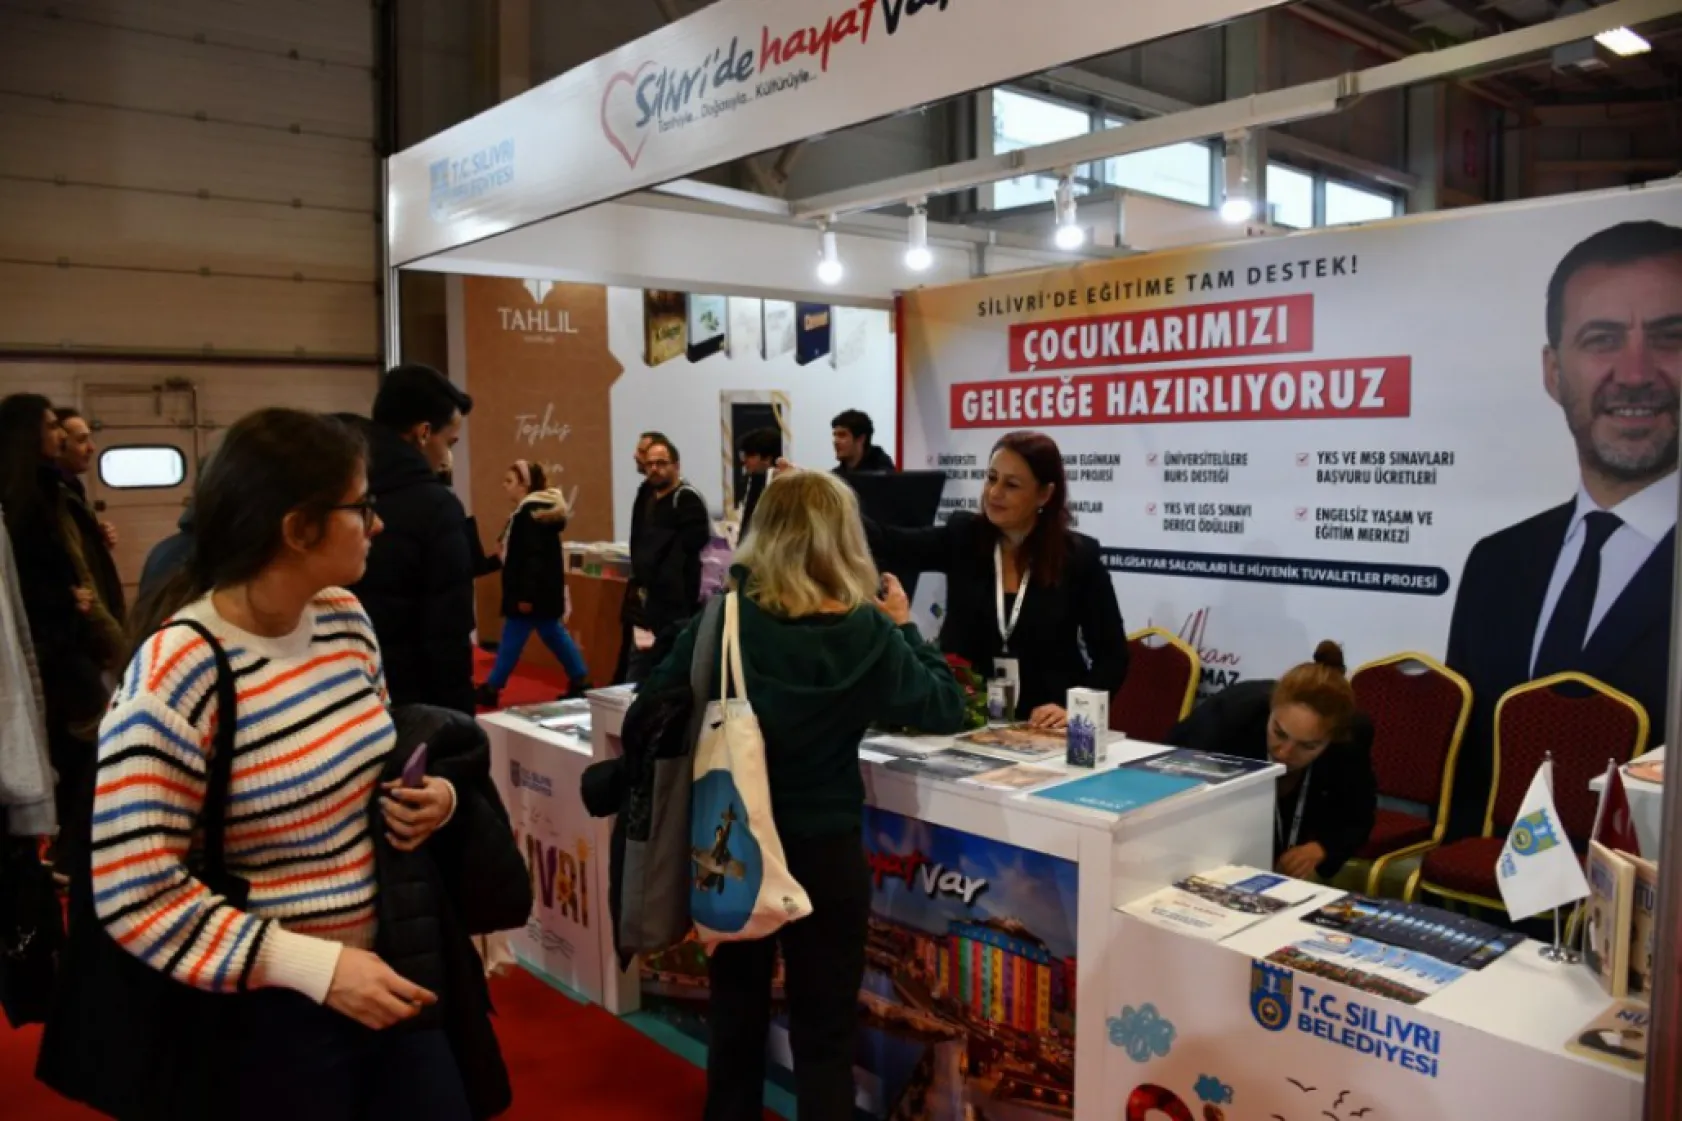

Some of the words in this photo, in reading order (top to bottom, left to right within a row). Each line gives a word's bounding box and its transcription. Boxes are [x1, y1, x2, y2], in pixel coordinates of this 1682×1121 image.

[759, 0, 877, 72] hayat
[977, 289, 1077, 318] SİLİVRİ'DE
[1087, 276, 1175, 305] EĞİTİME
[1187, 270, 1235, 292] TAM
[1247, 254, 1358, 285] DESTEK!
[1023, 304, 1288, 371] ÇOCUKLARIMIZI
[962, 374, 1093, 421] GELECEĞE
[1107, 367, 1386, 416] HAZIRLIYORUZ
[1317, 451, 1339, 465] YKS
[1342, 451, 1356, 465] VE
[1360, 451, 1385, 465] MSB
[1390, 450, 1454, 466] SINAVLARI
[1317, 469, 1371, 485] BAŞVURU
[1374, 466, 1437, 485] ÜCRETLERİ
[1315, 505, 1368, 522] ENGELSİZ
[1372, 509, 1413, 525] YAŞAM
[1417, 510, 1433, 525] VE
[1315, 523, 1354, 541] EĞİTİM
[1357, 526, 1409, 543] MERKEZİ
[1302, 567, 1381, 585] TUVALETLER
[1383, 572, 1437, 589] PROJESİ
[921, 863, 987, 904] Var
[1299, 986, 1341, 1020] T.C.
